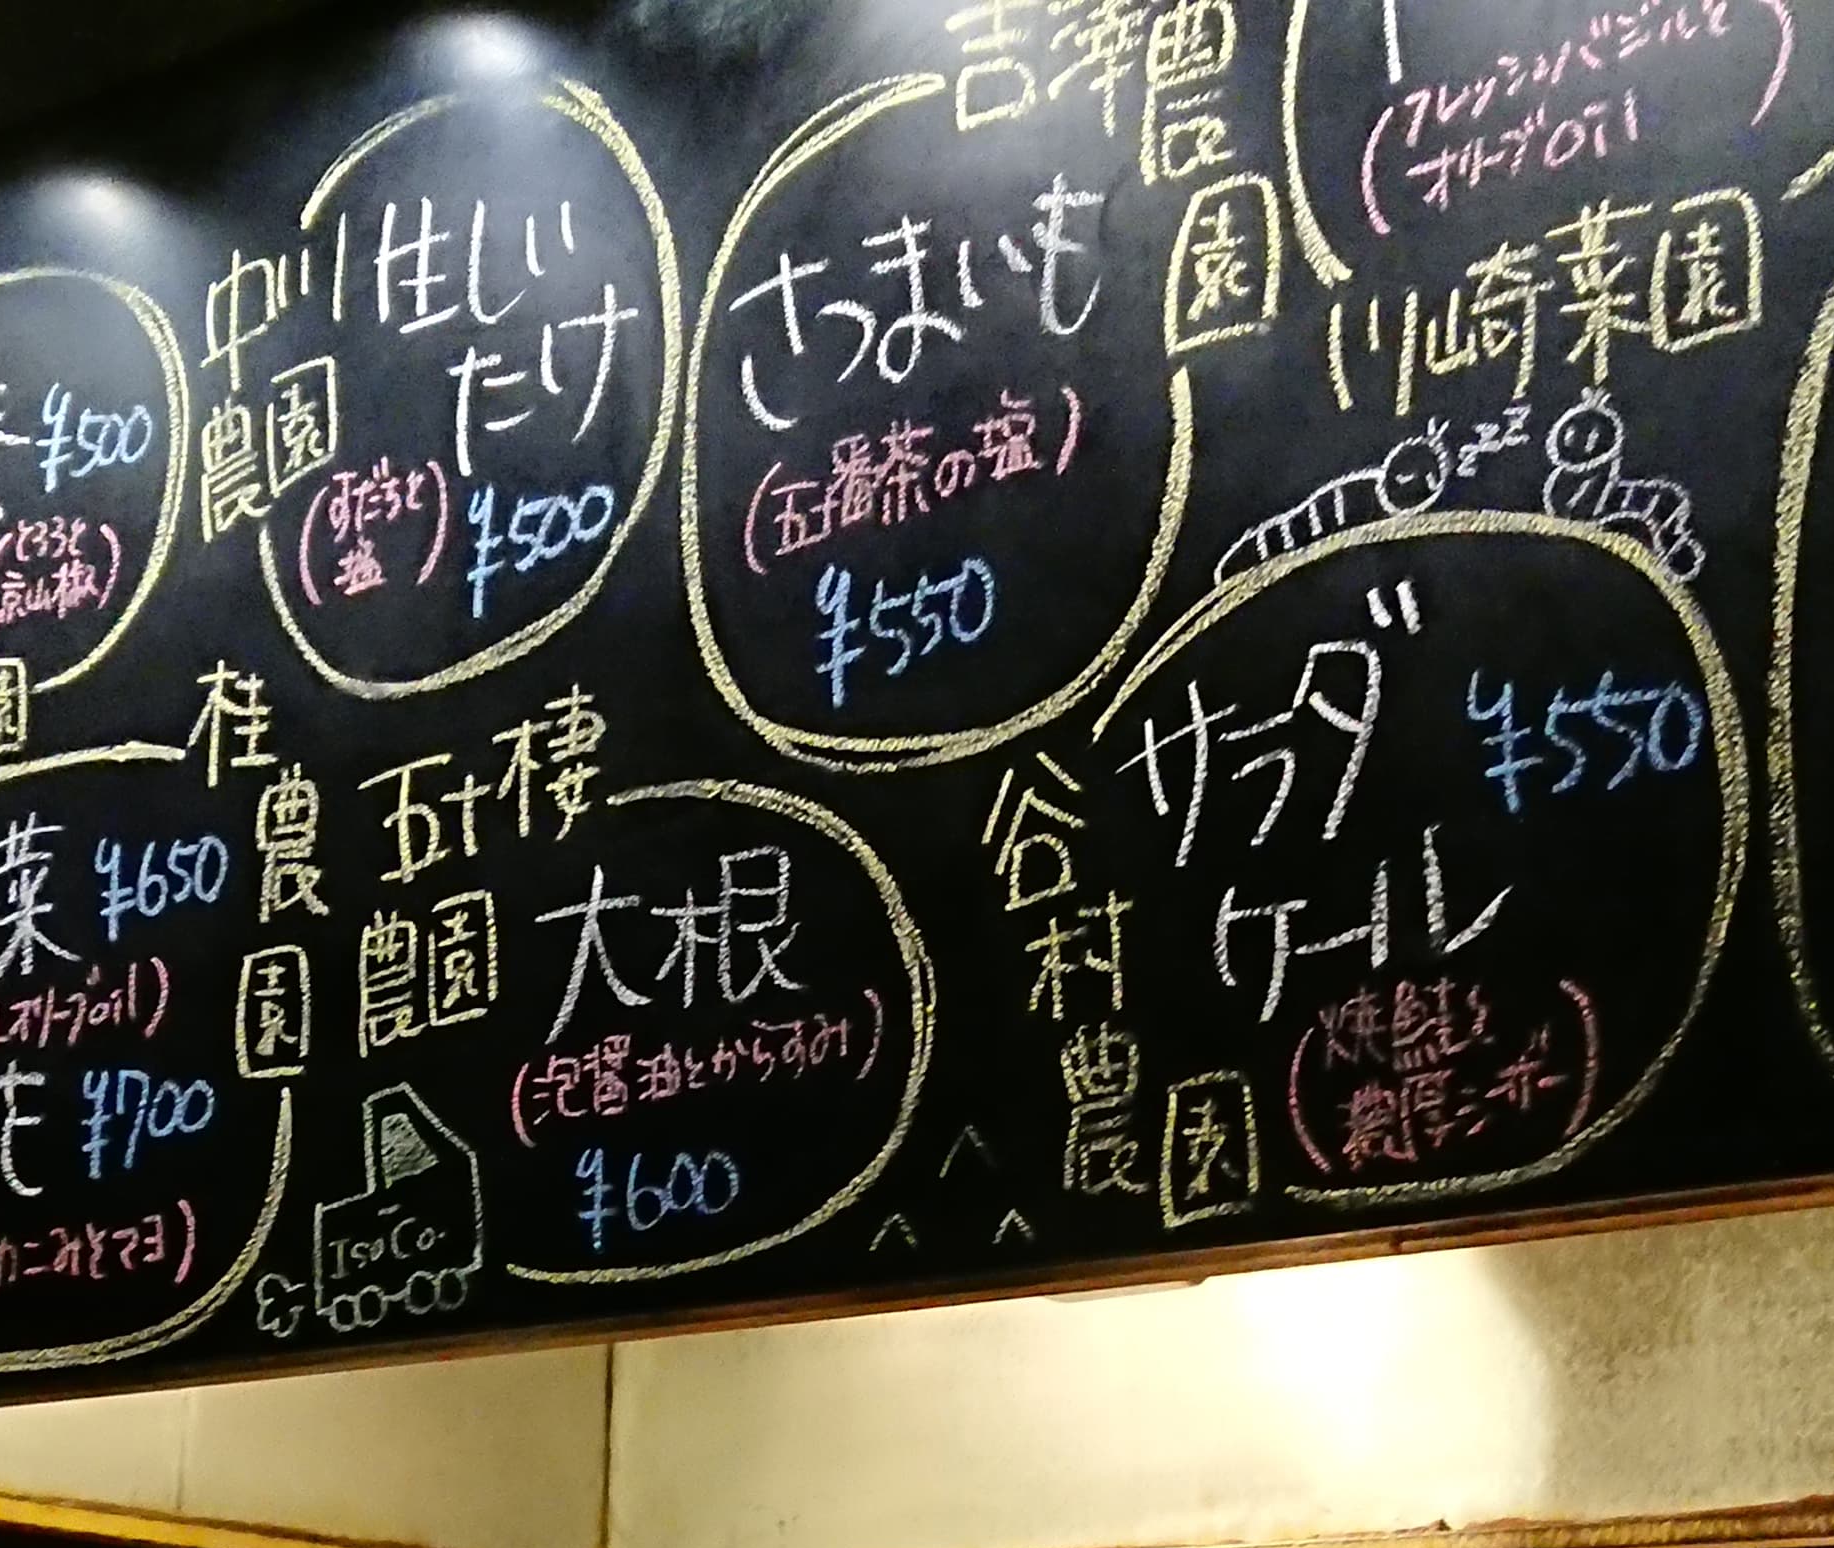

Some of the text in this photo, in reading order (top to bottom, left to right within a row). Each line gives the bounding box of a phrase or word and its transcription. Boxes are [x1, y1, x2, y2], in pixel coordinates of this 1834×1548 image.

[201, 212, 348, 392] 中川
[446, 284, 639, 477] たけ
[729, 173, 1105, 431] さつまいも
[1327, 186, 1765, 416] 川崎菜園
[34, 381, 154, 494] ¥500
[201, 355, 337, 543] 農園
[466, 483, 616, 620] ¥500
[814, 556, 997, 710] ¥550
[1115, 577, 1421, 868] サラダ
[1467, 668, 1704, 813] ¥550
[95, 834, 230, 942] ¥650
[359, 888, 499, 1059] 農園
[534, 843, 809, 1045] 大根
[1212, 823, 1515, 1023] ケール
[980, 750, 1262, 1230] 谷村農園
[81, 1069, 217, 1180] ¥700
[575, 1147, 740, 1254] ¥600
